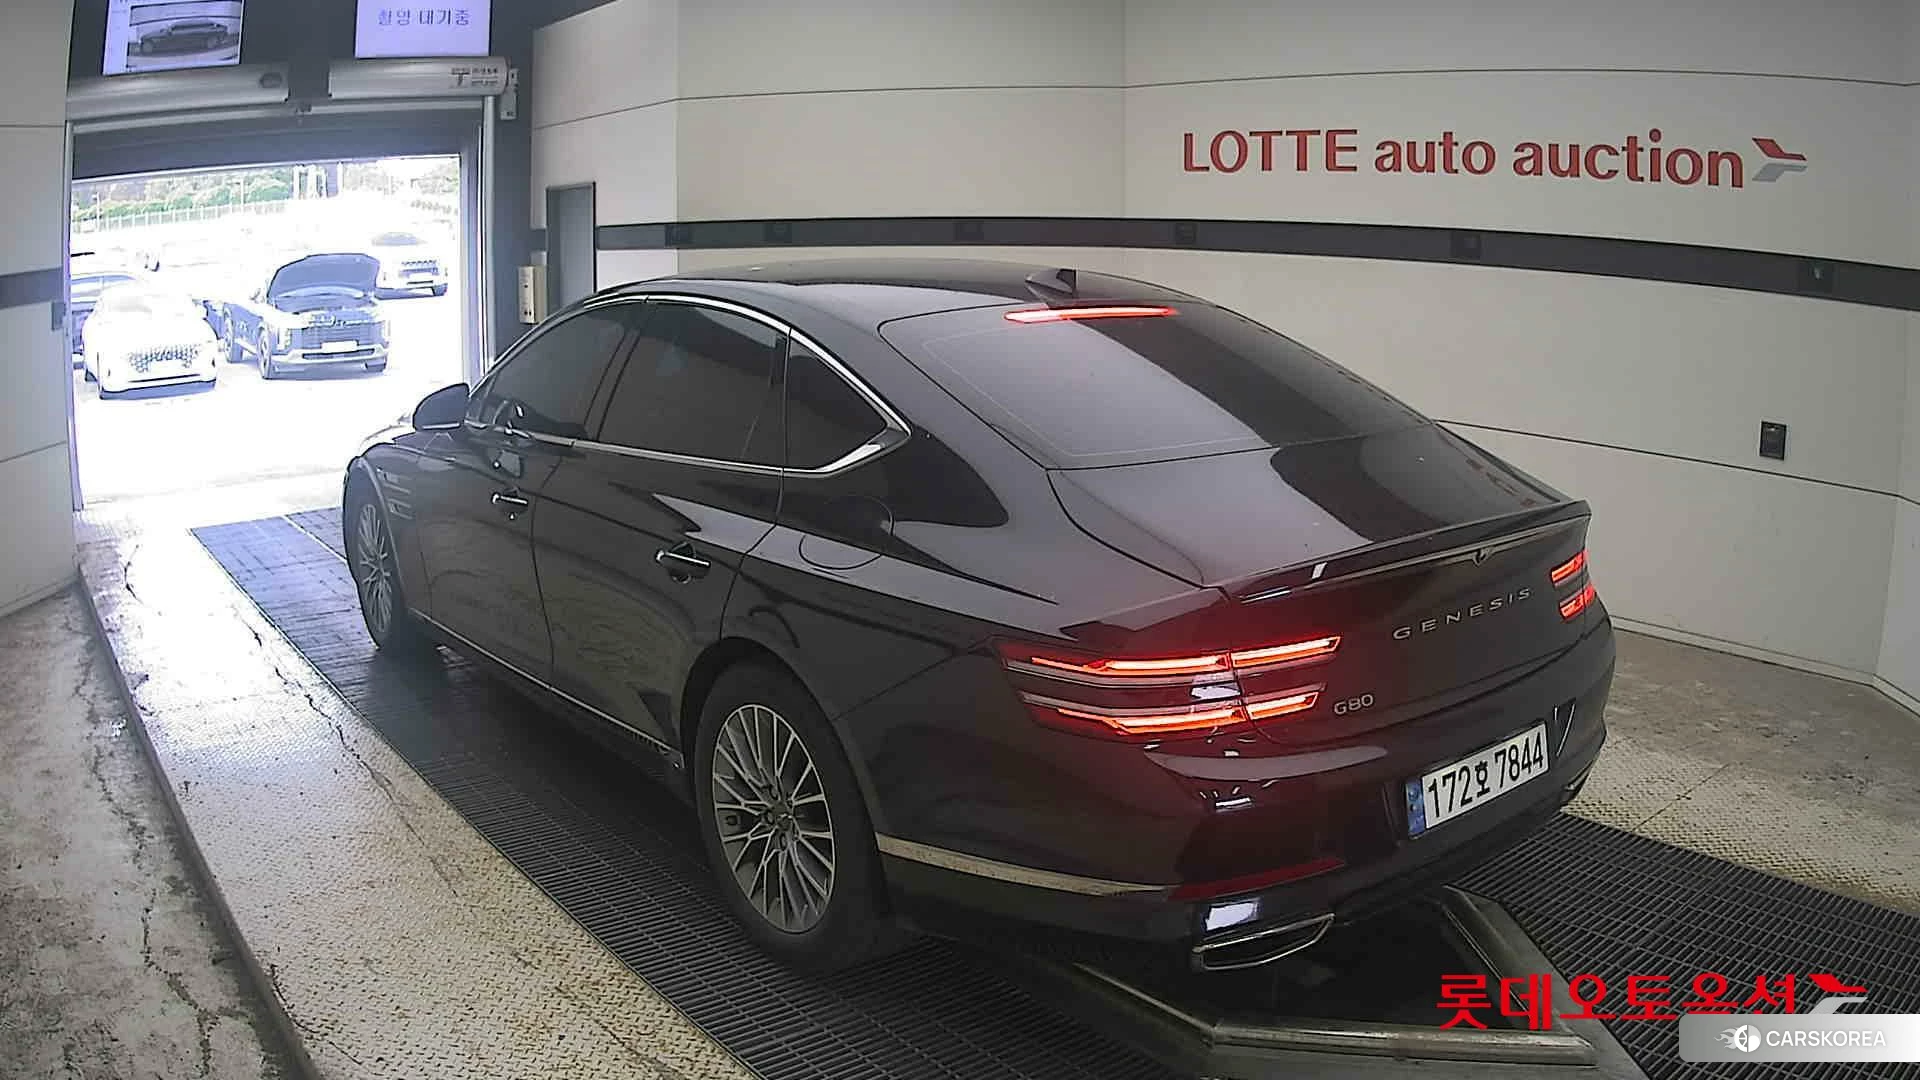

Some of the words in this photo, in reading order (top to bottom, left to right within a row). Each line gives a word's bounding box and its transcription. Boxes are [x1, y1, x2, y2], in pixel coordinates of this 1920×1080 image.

[418, 8, 470, 26] 대기중
[1183, 129, 1358, 173] LOTTE
[1375, 130, 1497, 176] auto
[1512, 128, 1744, 188] auction
[1393, 588, 1532, 640] GENESIS
[1334, 694, 1375, 715] G80
[1428, 761, 1491, 818] 172호
[1494, 731, 1544, 789] 7844
